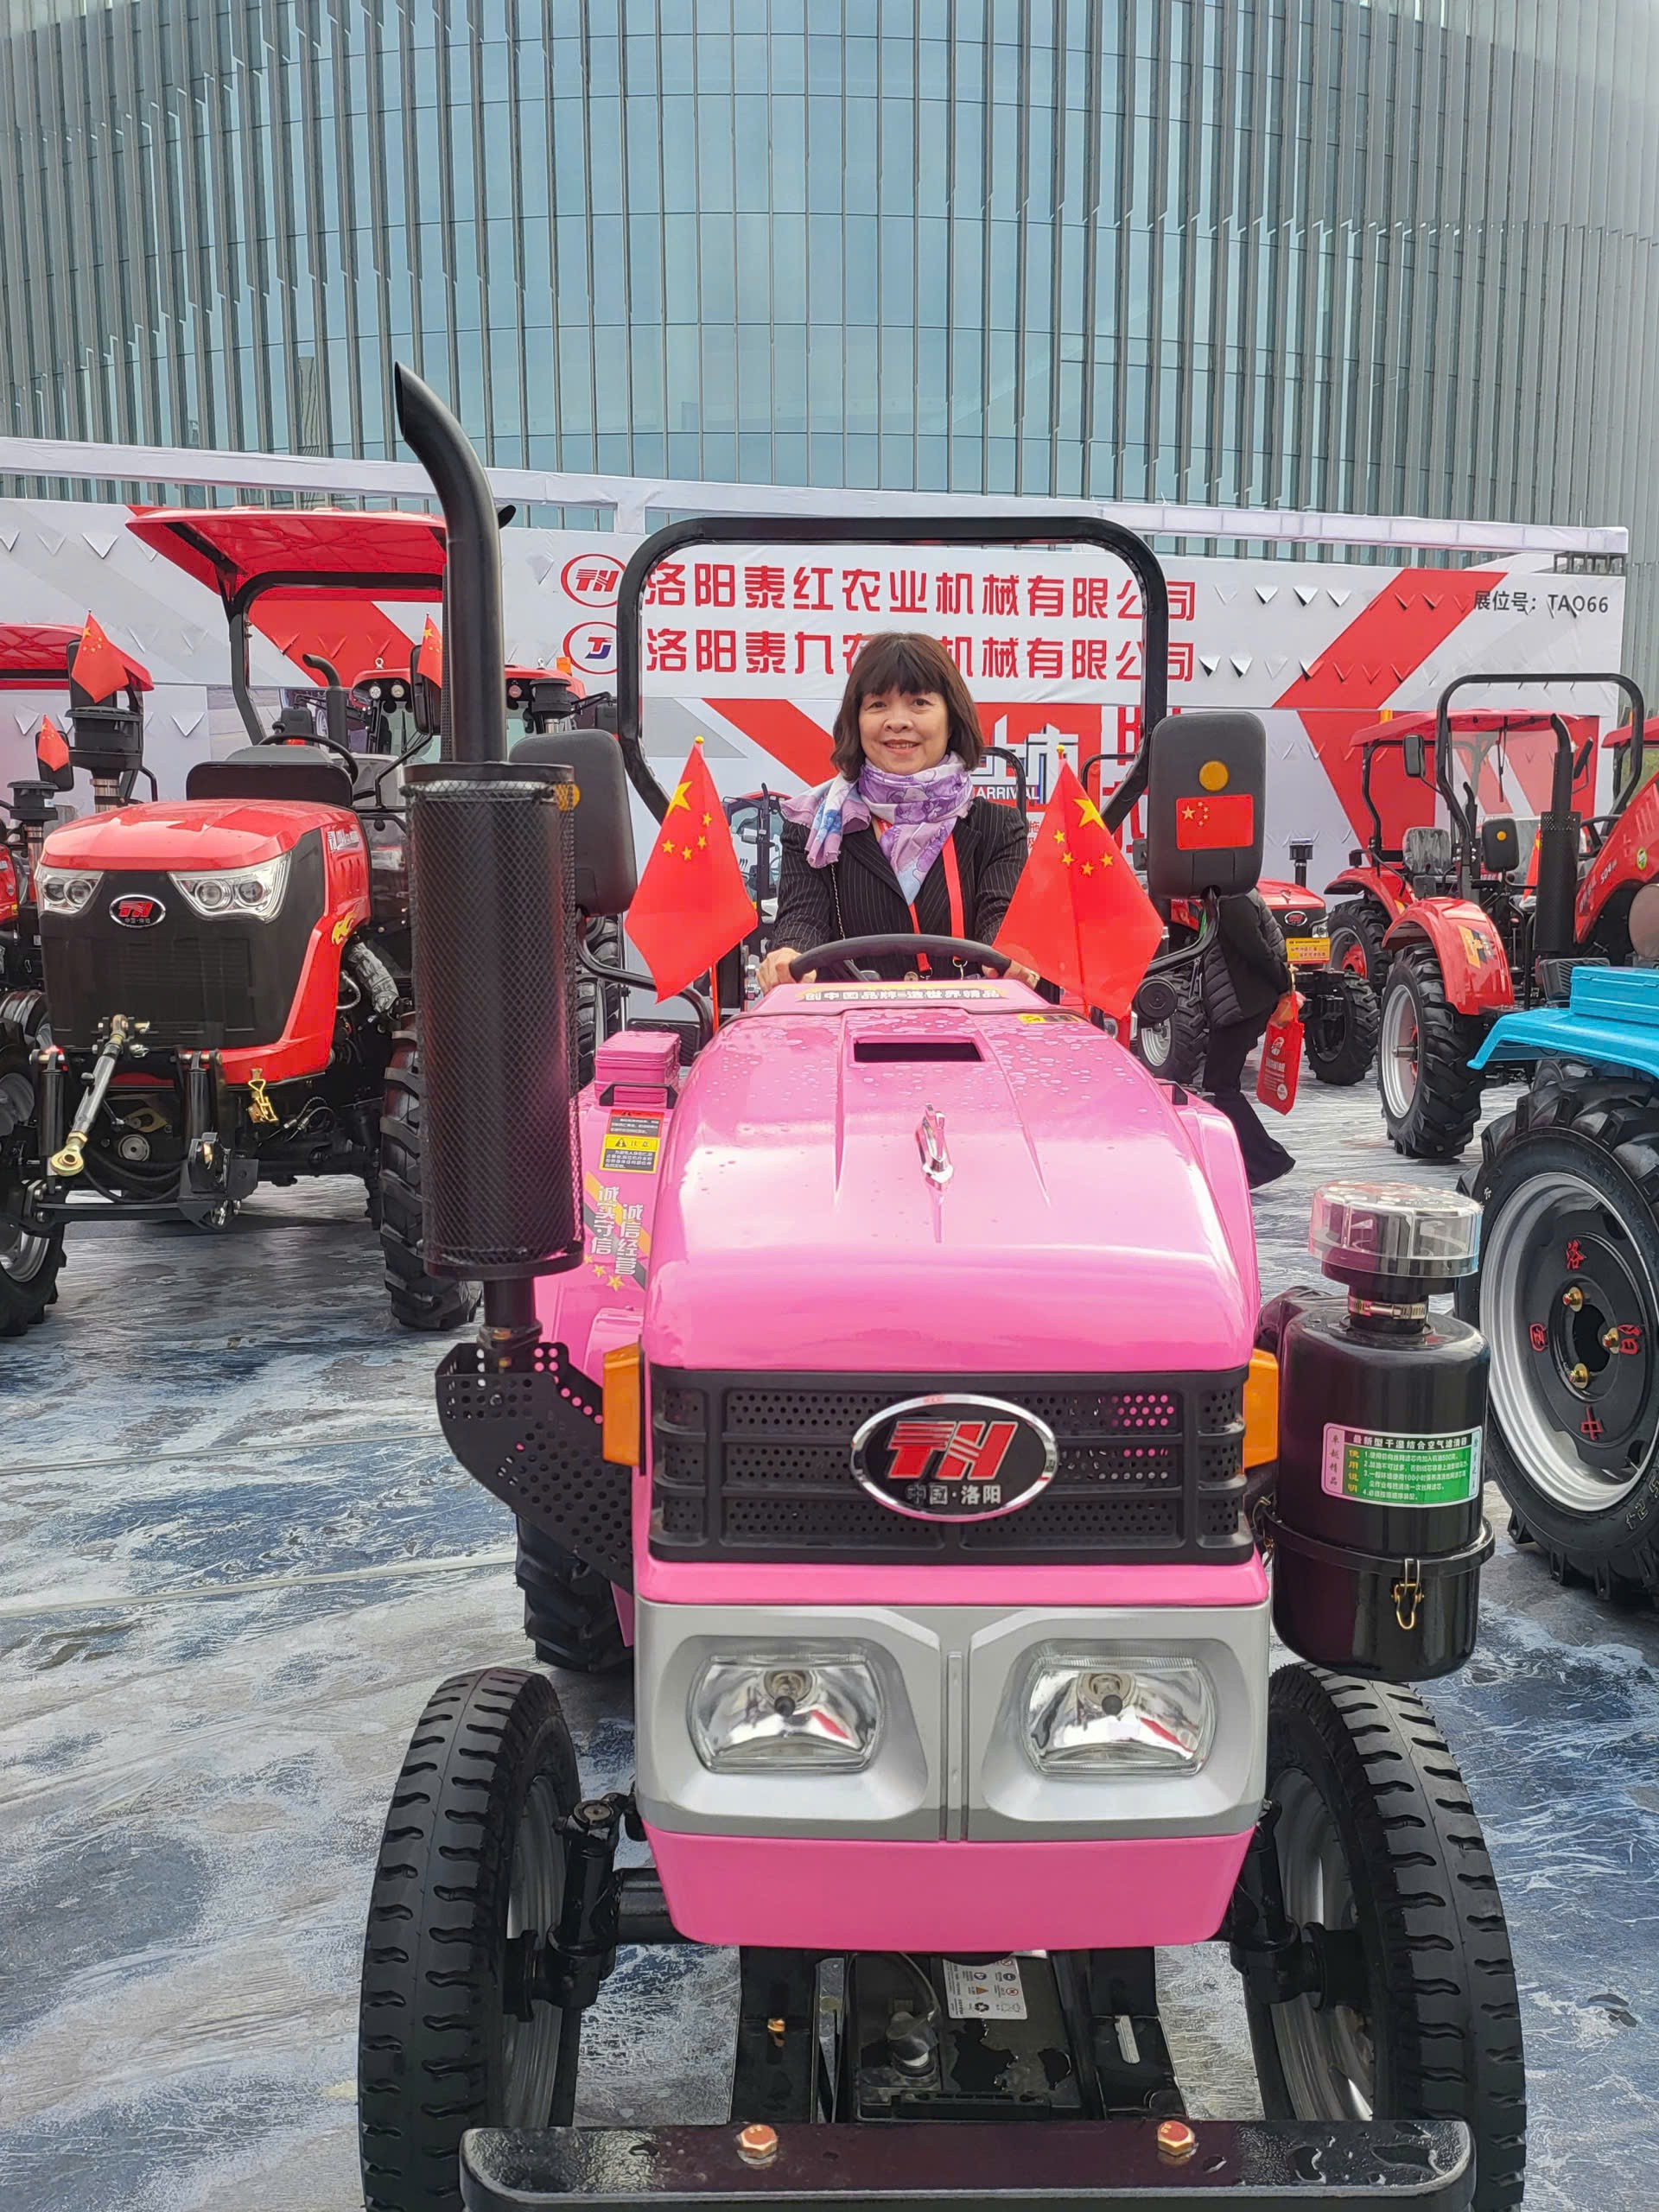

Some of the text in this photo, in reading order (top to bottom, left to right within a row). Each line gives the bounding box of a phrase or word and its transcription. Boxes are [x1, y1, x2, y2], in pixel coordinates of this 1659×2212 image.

[645, 562, 1196, 621] 洛阳泰红农业机械有限公司
[646, 627, 1194, 682] 洛阳泰九农机械有限公司
[591, 1185, 620, 1255] 诚实守信
[614, 1203, 644, 1275] 诚信经营
[887, 1421, 1019, 1481] TH
